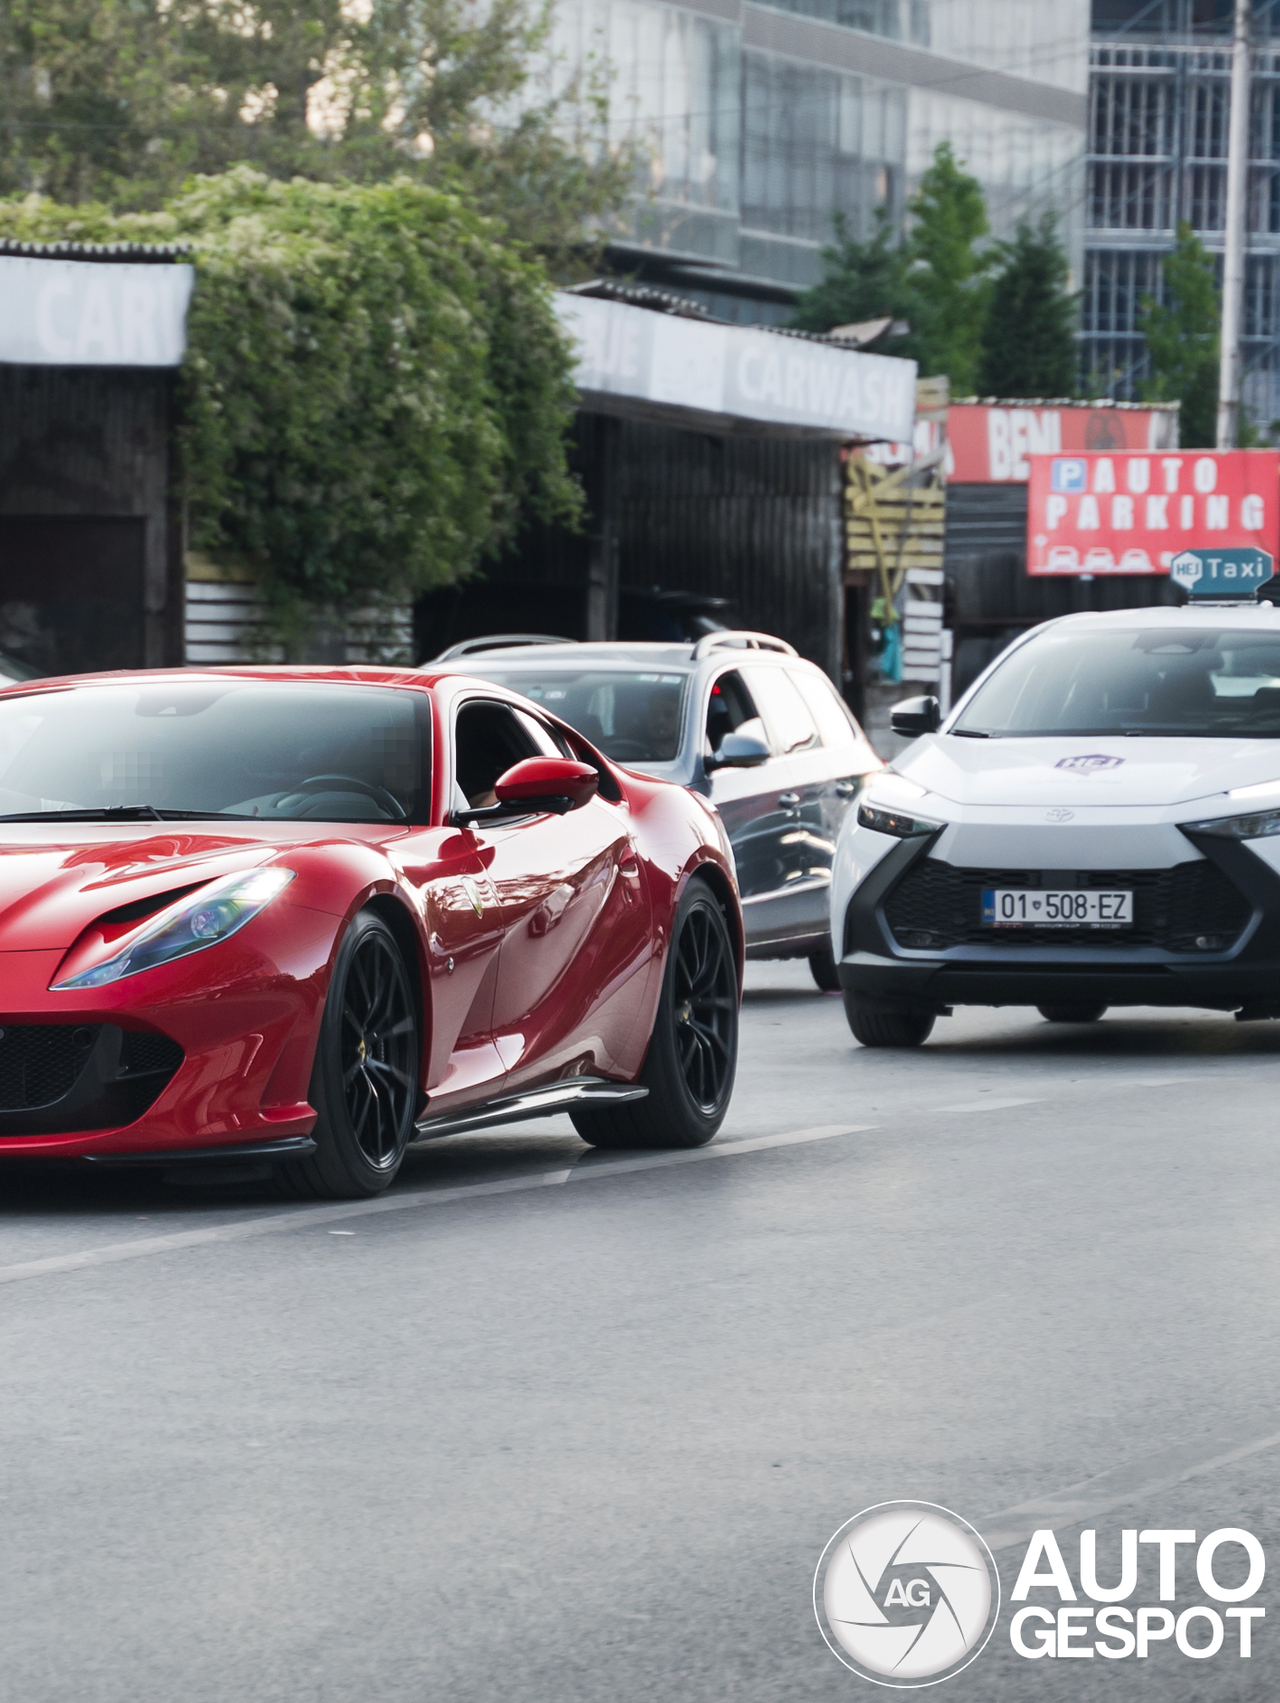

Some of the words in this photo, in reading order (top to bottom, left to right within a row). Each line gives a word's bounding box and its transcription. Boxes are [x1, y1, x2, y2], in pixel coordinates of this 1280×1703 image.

[33, 277, 176, 360] CAR
[737, 345, 904, 426] CARWASH
[1093, 457, 1218, 494] AUTO
[1045, 494, 1265, 530] PARKING
[1176, 563, 1199, 576] HEJ
[1206, 557, 1263, 578] Taxi
[1001, 893, 1026, 919] 01
[1046, 893, 1127, 919] 508-EZ
